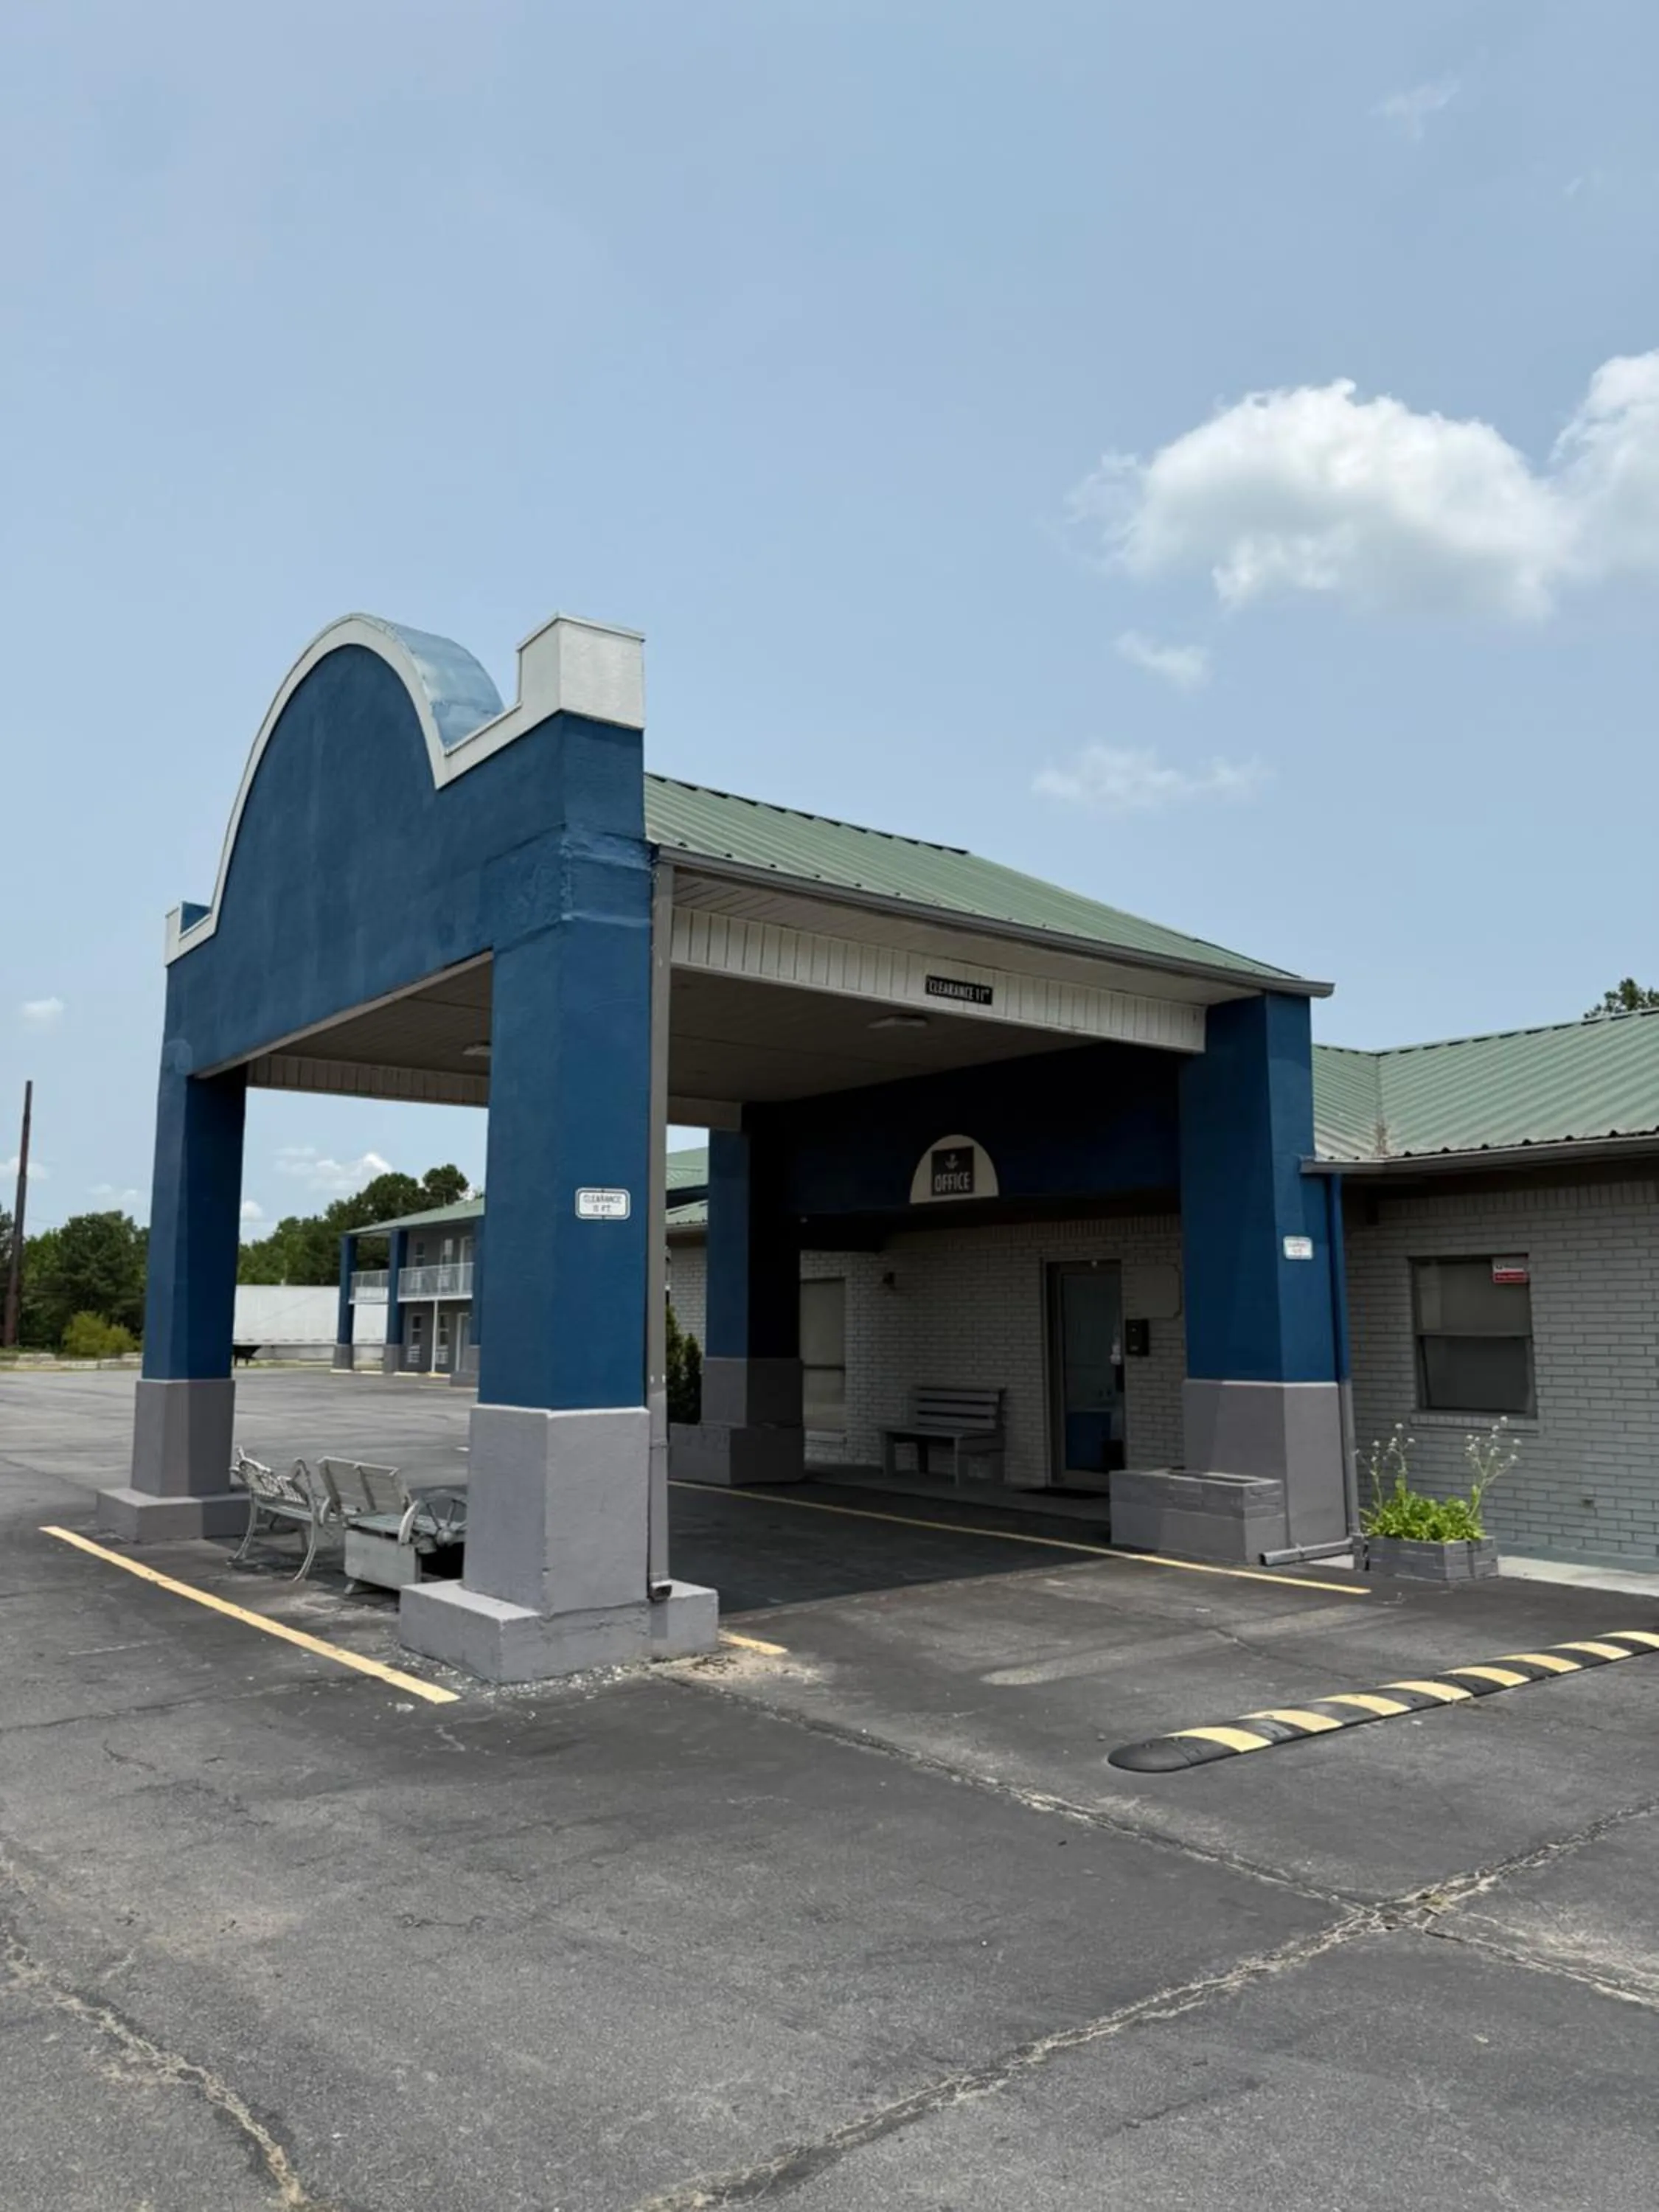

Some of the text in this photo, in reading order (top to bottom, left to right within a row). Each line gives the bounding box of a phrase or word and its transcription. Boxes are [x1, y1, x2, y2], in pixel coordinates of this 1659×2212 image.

[929, 979, 974, 1000] CLEARANCE
[934, 1172, 971, 1192] OFFICE
[583, 1194, 622, 1203] CLEARANCE
